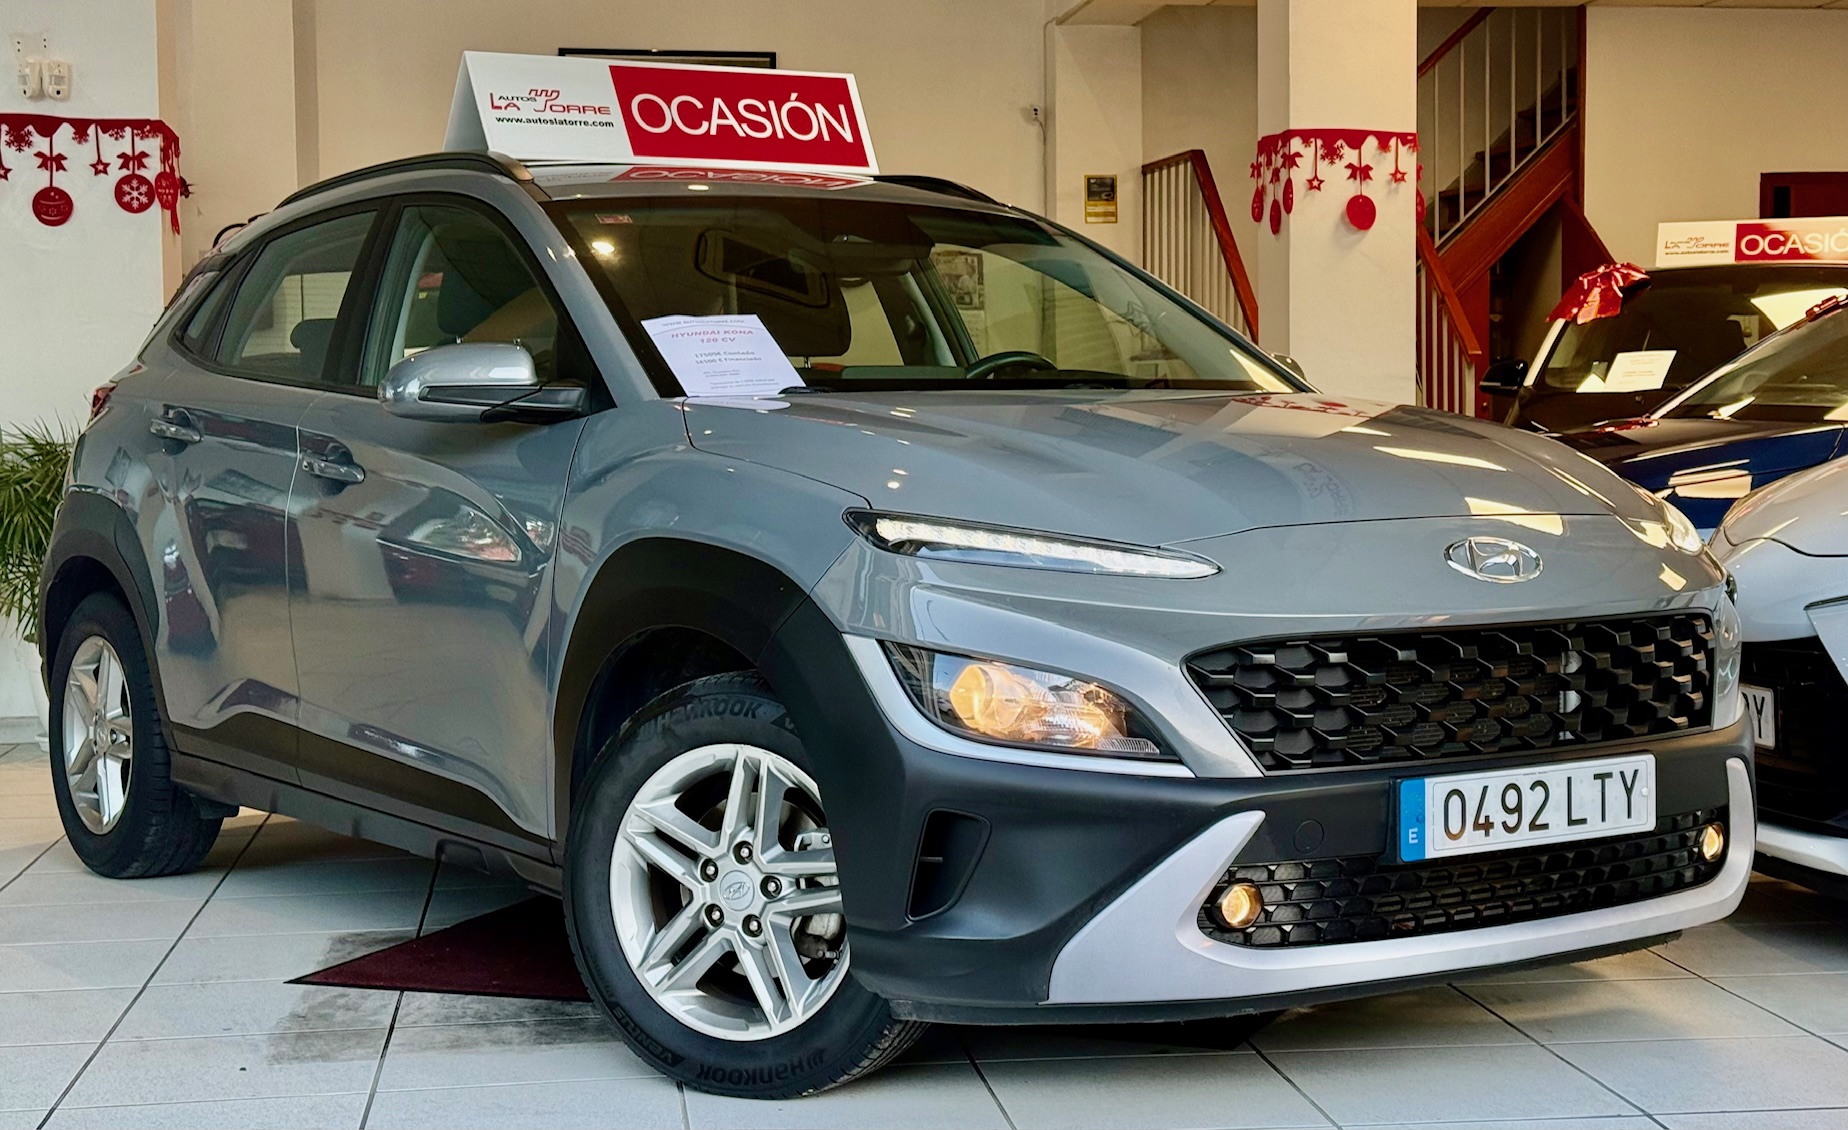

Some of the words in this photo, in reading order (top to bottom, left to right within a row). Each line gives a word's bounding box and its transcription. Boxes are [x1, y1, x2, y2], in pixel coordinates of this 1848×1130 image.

[489, 92, 521, 111] LA
[495, 116, 614, 128] www.autoslatorre.com
[630, 92, 854, 143] OCASIÓN
[671, 330, 720, 339] HYUNDAI
[1443, 779, 1550, 841] 0492
[1566, 769, 1640, 827] LTY
[1408, 828, 1419, 844] E
